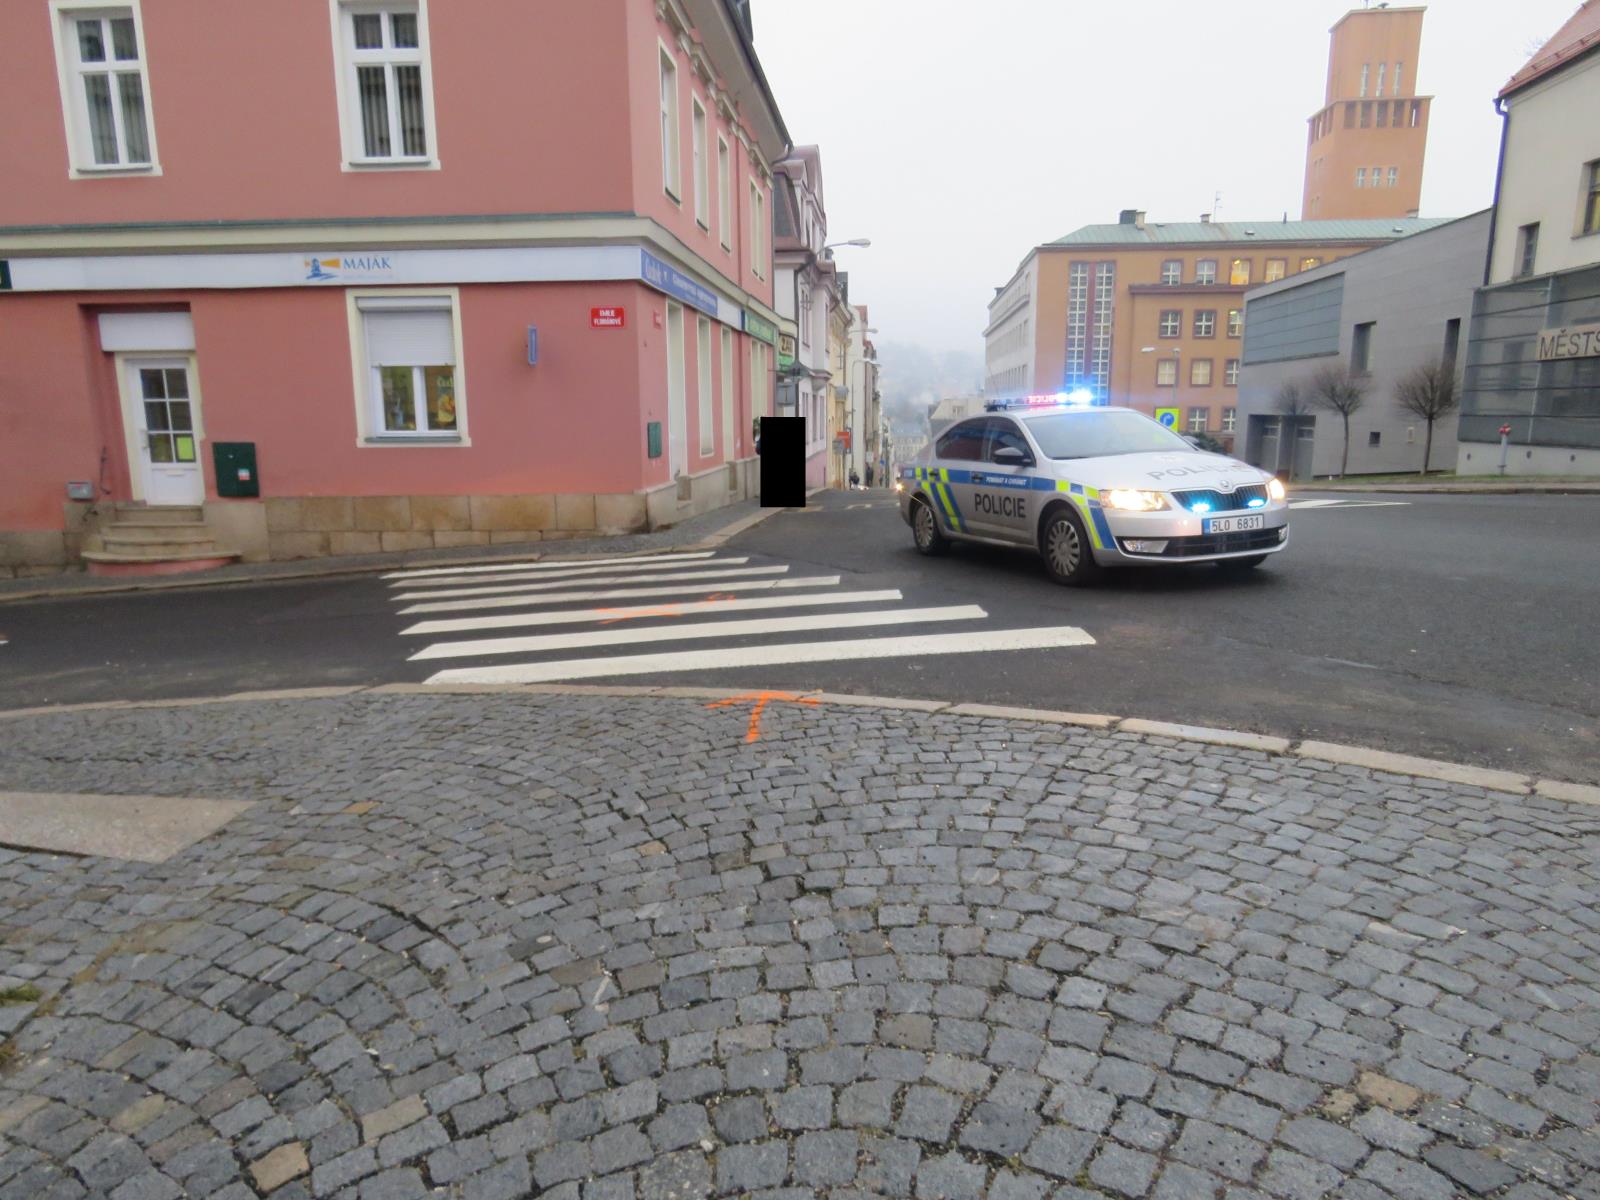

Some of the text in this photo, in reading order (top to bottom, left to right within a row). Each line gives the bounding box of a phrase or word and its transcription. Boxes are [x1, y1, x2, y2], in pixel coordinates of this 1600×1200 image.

[343, 254, 391, 270] MAJÁK
[974, 492, 1026, 518] POLICIE
[1237, 517, 1260, 530] 6831
